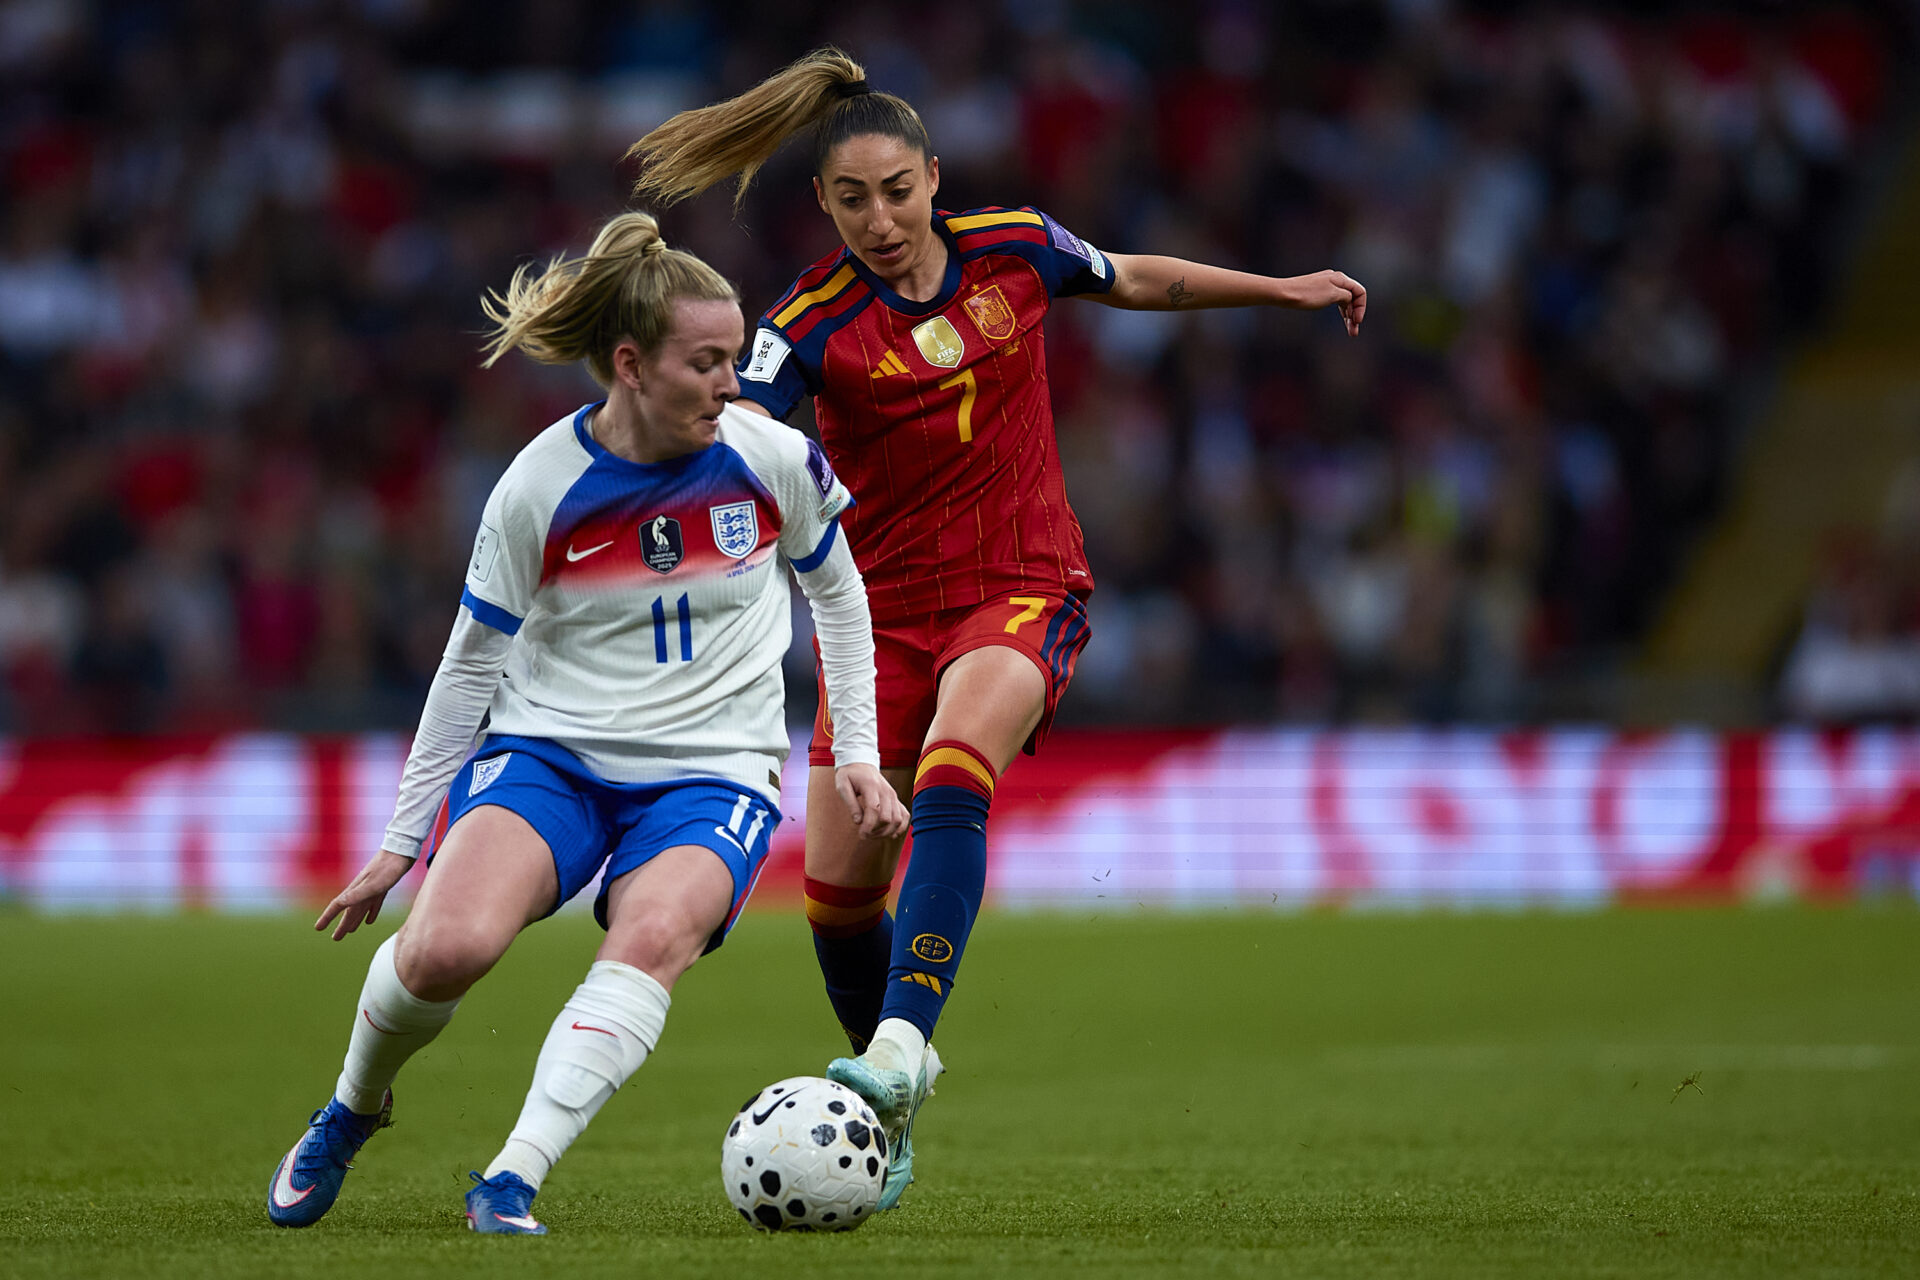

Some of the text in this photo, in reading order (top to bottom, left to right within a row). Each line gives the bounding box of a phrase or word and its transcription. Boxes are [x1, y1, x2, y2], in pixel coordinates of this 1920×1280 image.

[937, 347, 956, 360] FIFA
[939, 369, 977, 443] 7
[650, 552, 676, 560] EUROPEAN
[651, 592, 693, 664] 11
[1003, 596, 1047, 635] 7
[727, 794, 770, 855] 11
